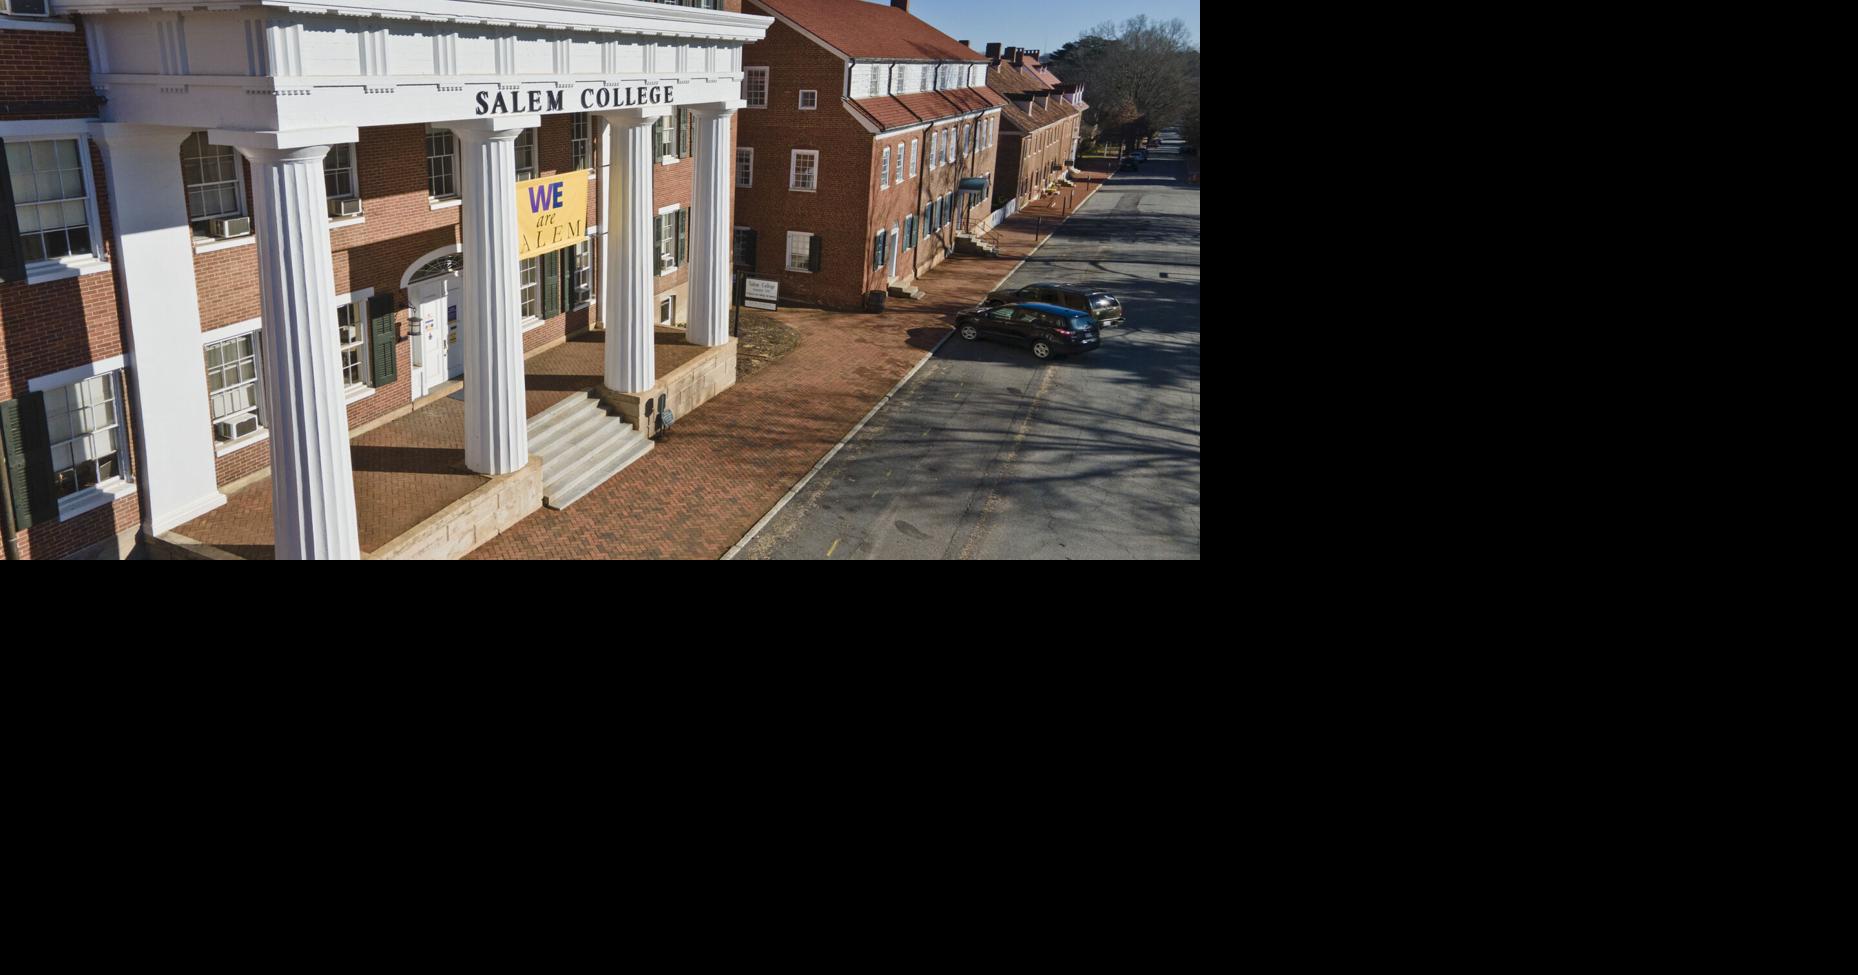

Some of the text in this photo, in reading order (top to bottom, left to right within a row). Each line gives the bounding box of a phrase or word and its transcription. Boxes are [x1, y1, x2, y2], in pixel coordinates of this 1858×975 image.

[475, 85, 674, 115] SALEM COLLEGE
[528, 181, 563, 213] WE
[536, 212, 556, 228] are
[520, 219, 581, 253] ALEM
